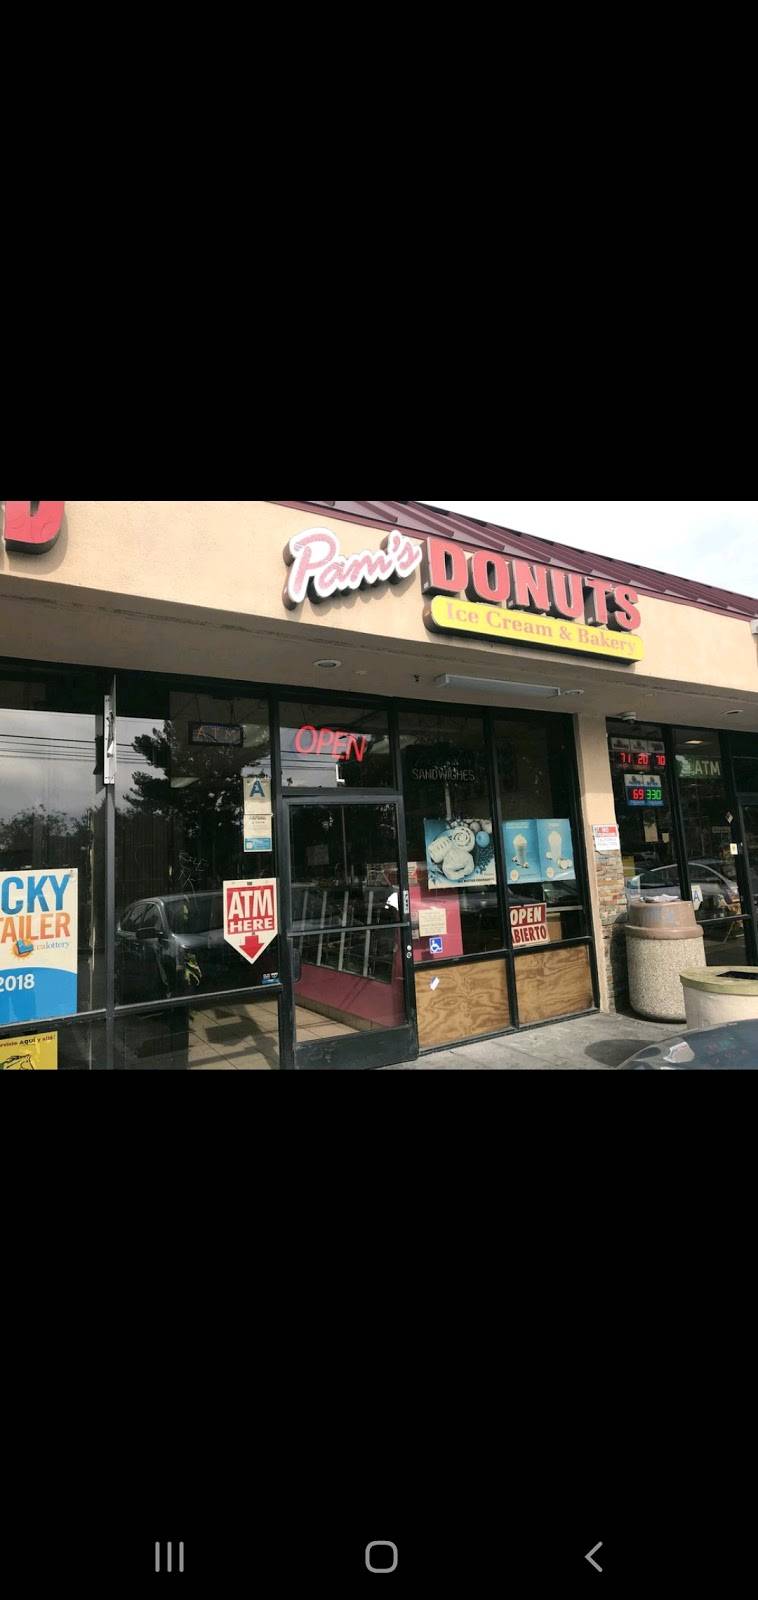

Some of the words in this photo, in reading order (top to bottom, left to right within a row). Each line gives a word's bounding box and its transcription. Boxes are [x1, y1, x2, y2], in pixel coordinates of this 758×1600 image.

[288, 528, 423, 603] Pam's
[427, 537, 641, 632] DONUTS
[447, 602, 480, 625] Ice
[486, 611, 553, 638] Cream
[559, 626, 572, 641] &
[577, 628, 637, 656] Bakery
[294, 724, 368, 763] OPEN
[695, 761, 721, 776] ATM
[249, 780, 266, 798] A
[632, 789, 645, 801] 69
[646, 789, 662, 801] 330
[227, 888, 274, 920] ATM
[229, 917, 274, 933] HERE
[510, 906, 542, 926] OPEN
